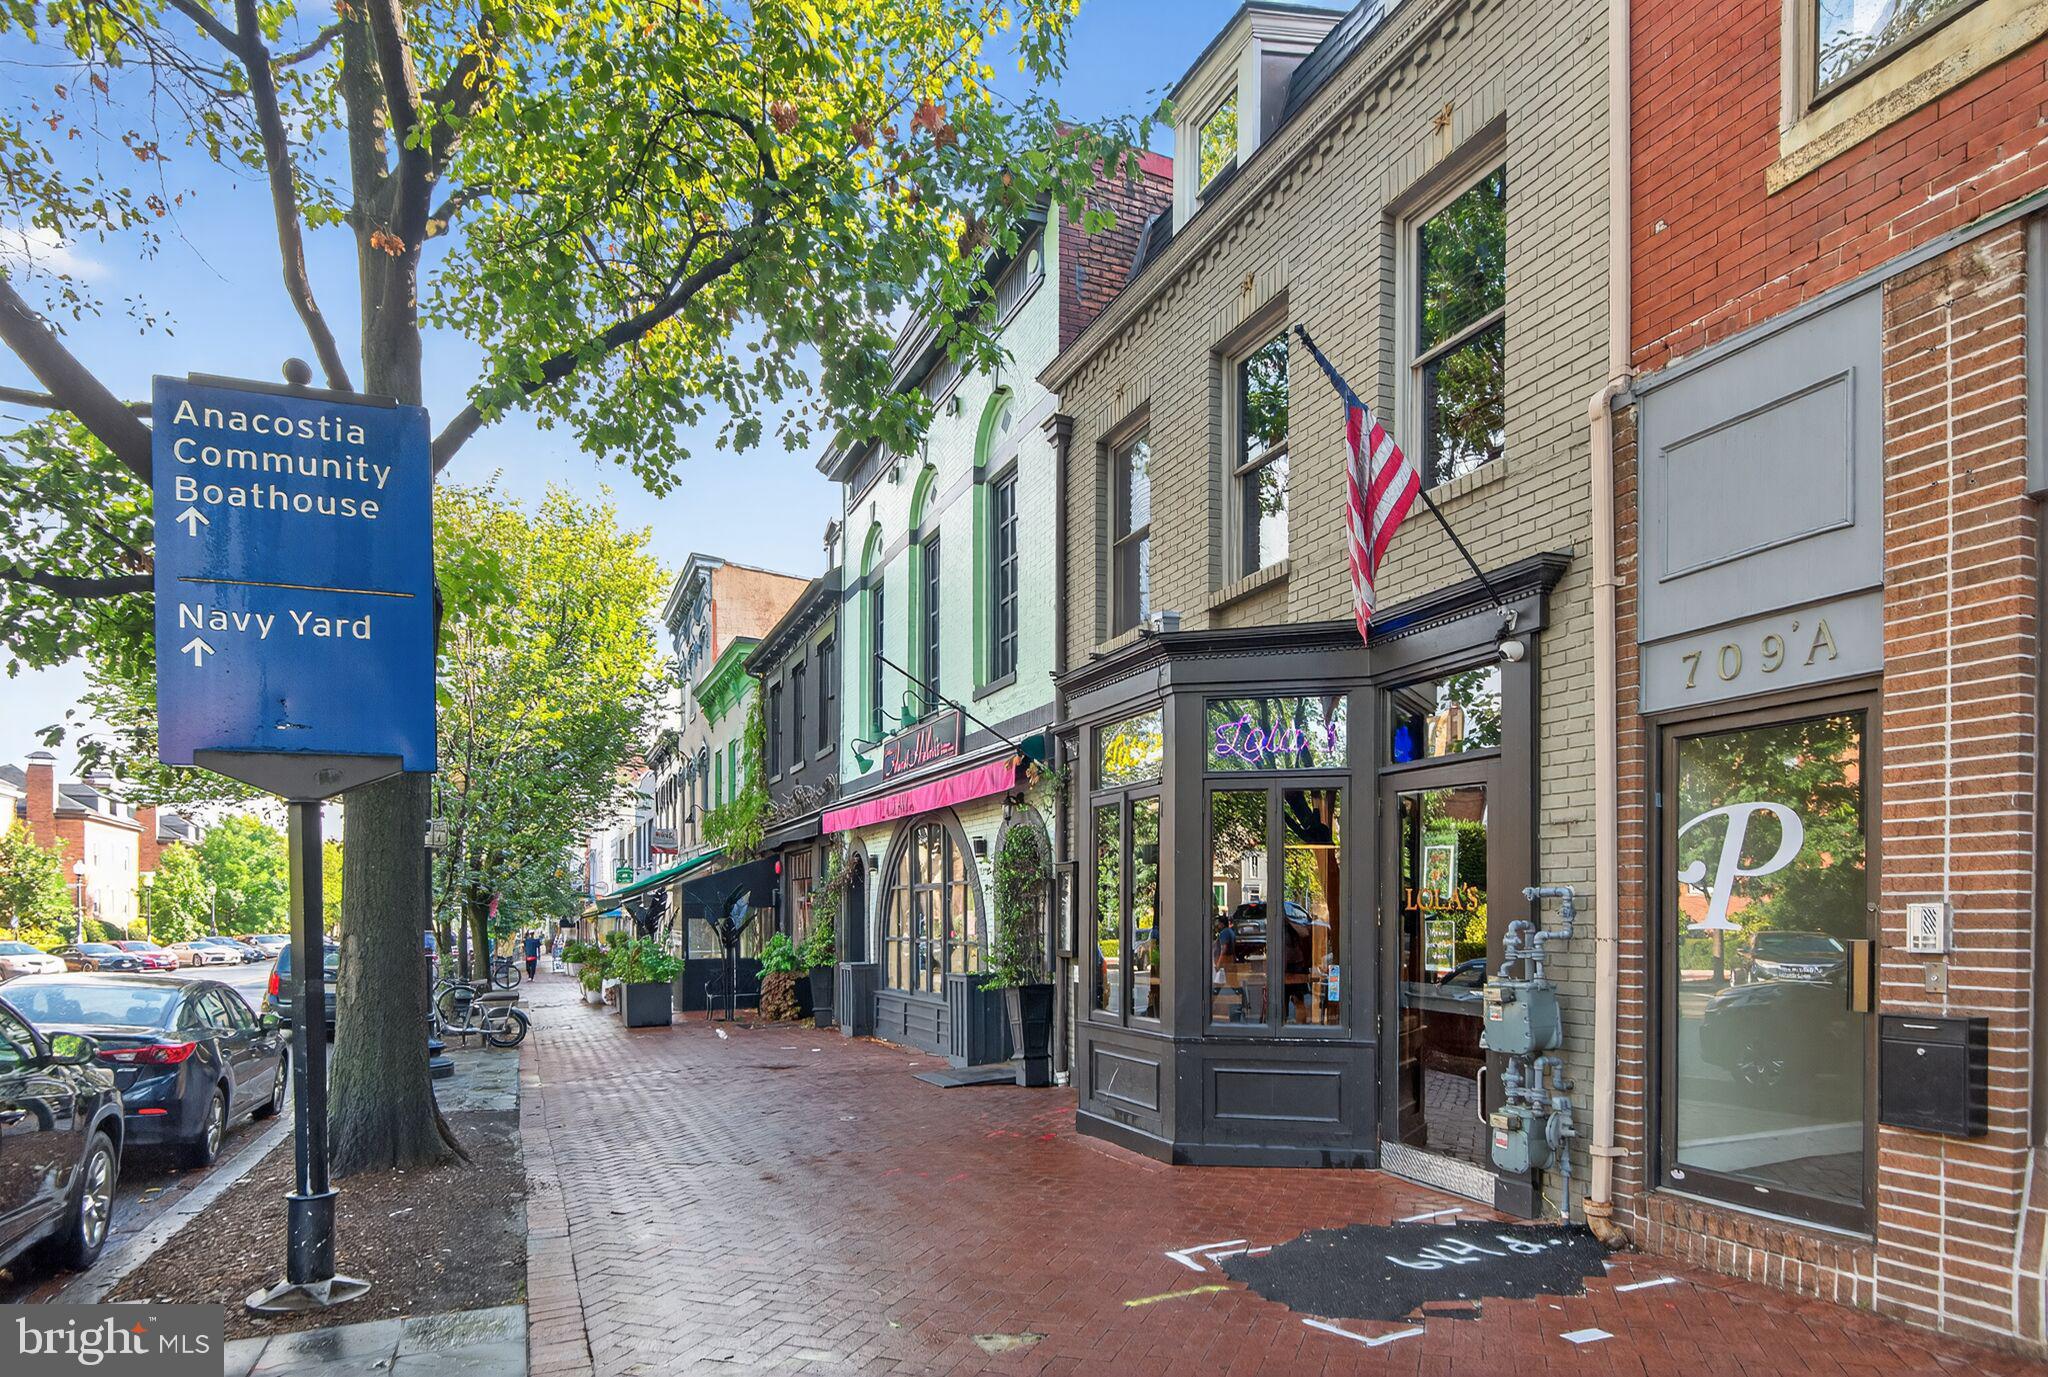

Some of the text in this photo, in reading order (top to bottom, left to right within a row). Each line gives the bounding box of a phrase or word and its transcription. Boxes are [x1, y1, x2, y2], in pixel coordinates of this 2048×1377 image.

[172, 399, 365, 445] Anacostia
[173, 437, 391, 490] Community
[175, 476, 380, 519] Boathouse
[178, 602, 371, 640] Navy Yard
[1677, 801, 1805, 930] P
[1405, 882, 1479, 911] LOLA'S
